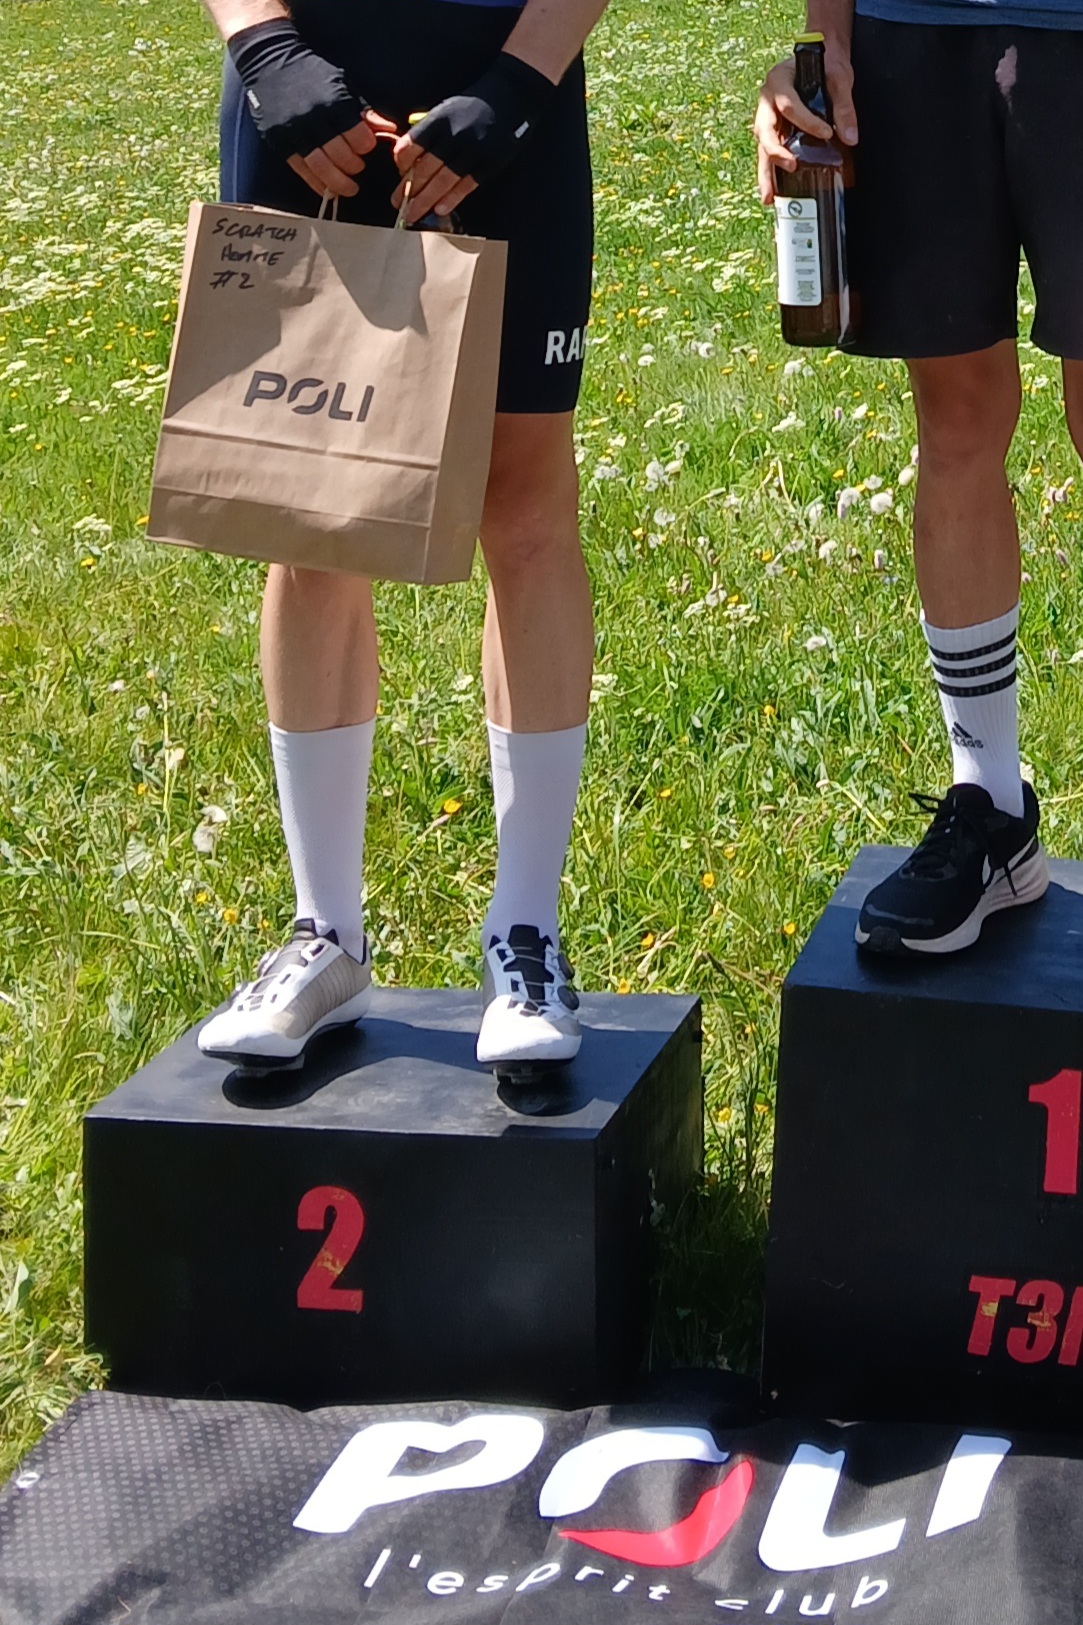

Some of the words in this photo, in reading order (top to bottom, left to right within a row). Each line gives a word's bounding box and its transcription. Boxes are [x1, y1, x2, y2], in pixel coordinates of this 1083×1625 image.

[212, 217, 297, 242] SCRATCH
[209, 270, 255, 290] #2
[242, 370, 375, 423] POLI
[1028, 1068, 1082, 1194] 1
[297, 1186, 365, 1314] 2
[292, 1413, 1012, 1572] POLI
[363, 1547, 671, 1602] l'esprit
[714, 1576, 889, 1617] club
